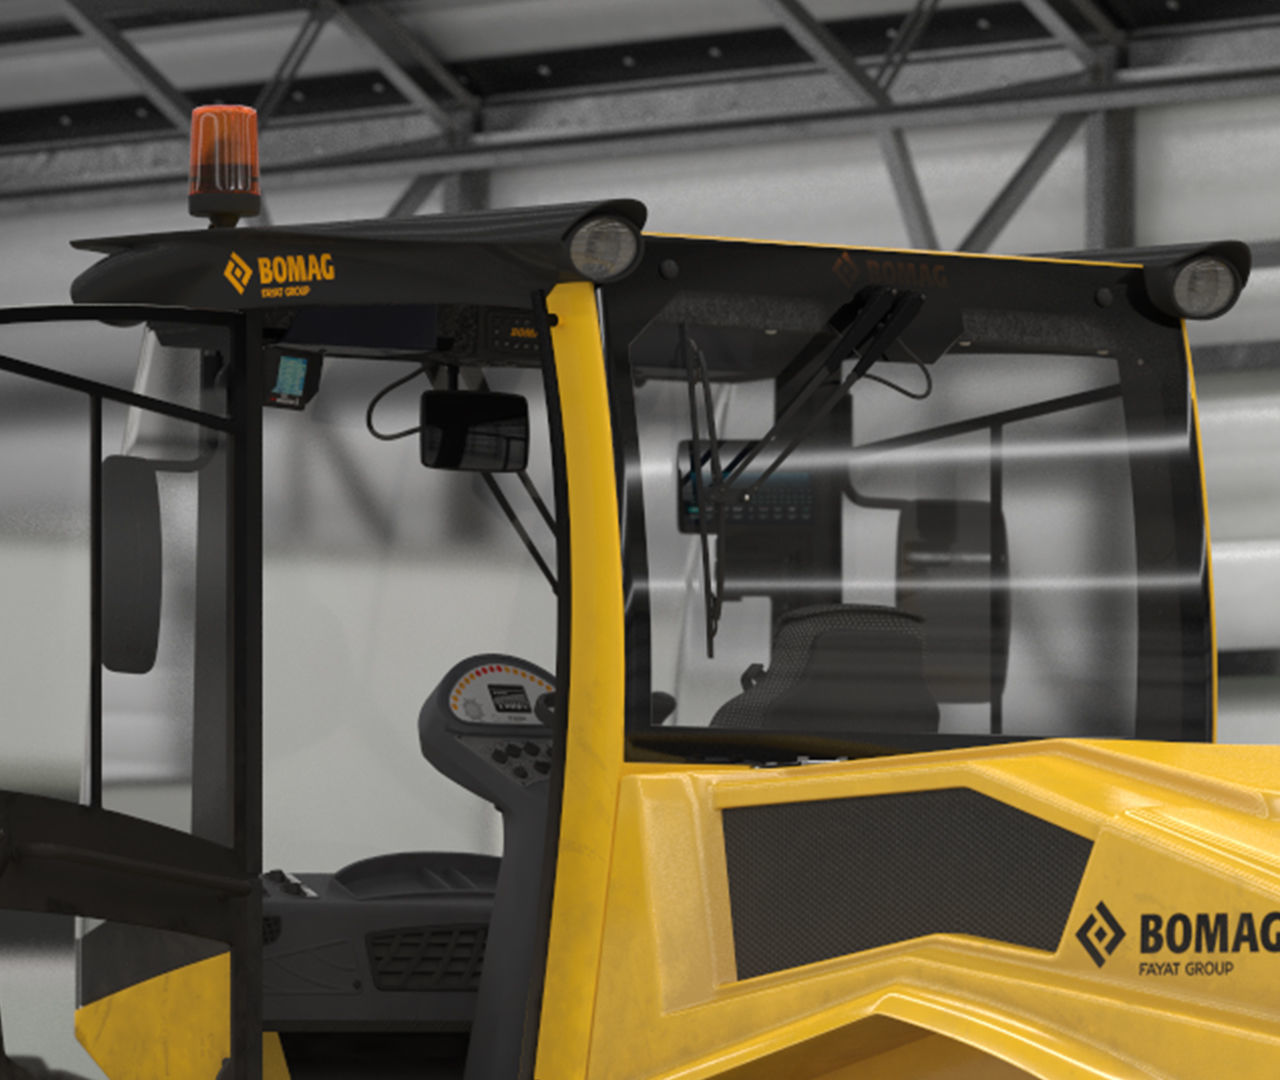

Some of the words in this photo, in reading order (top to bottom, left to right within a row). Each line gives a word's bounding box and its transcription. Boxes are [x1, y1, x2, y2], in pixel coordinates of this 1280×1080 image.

[257, 253, 335, 284] BOMAG
[865, 259, 949, 288] BOMAG
[1139, 962, 1180, 976] FAYAT
[1185, 961, 1234, 976] GROUP
